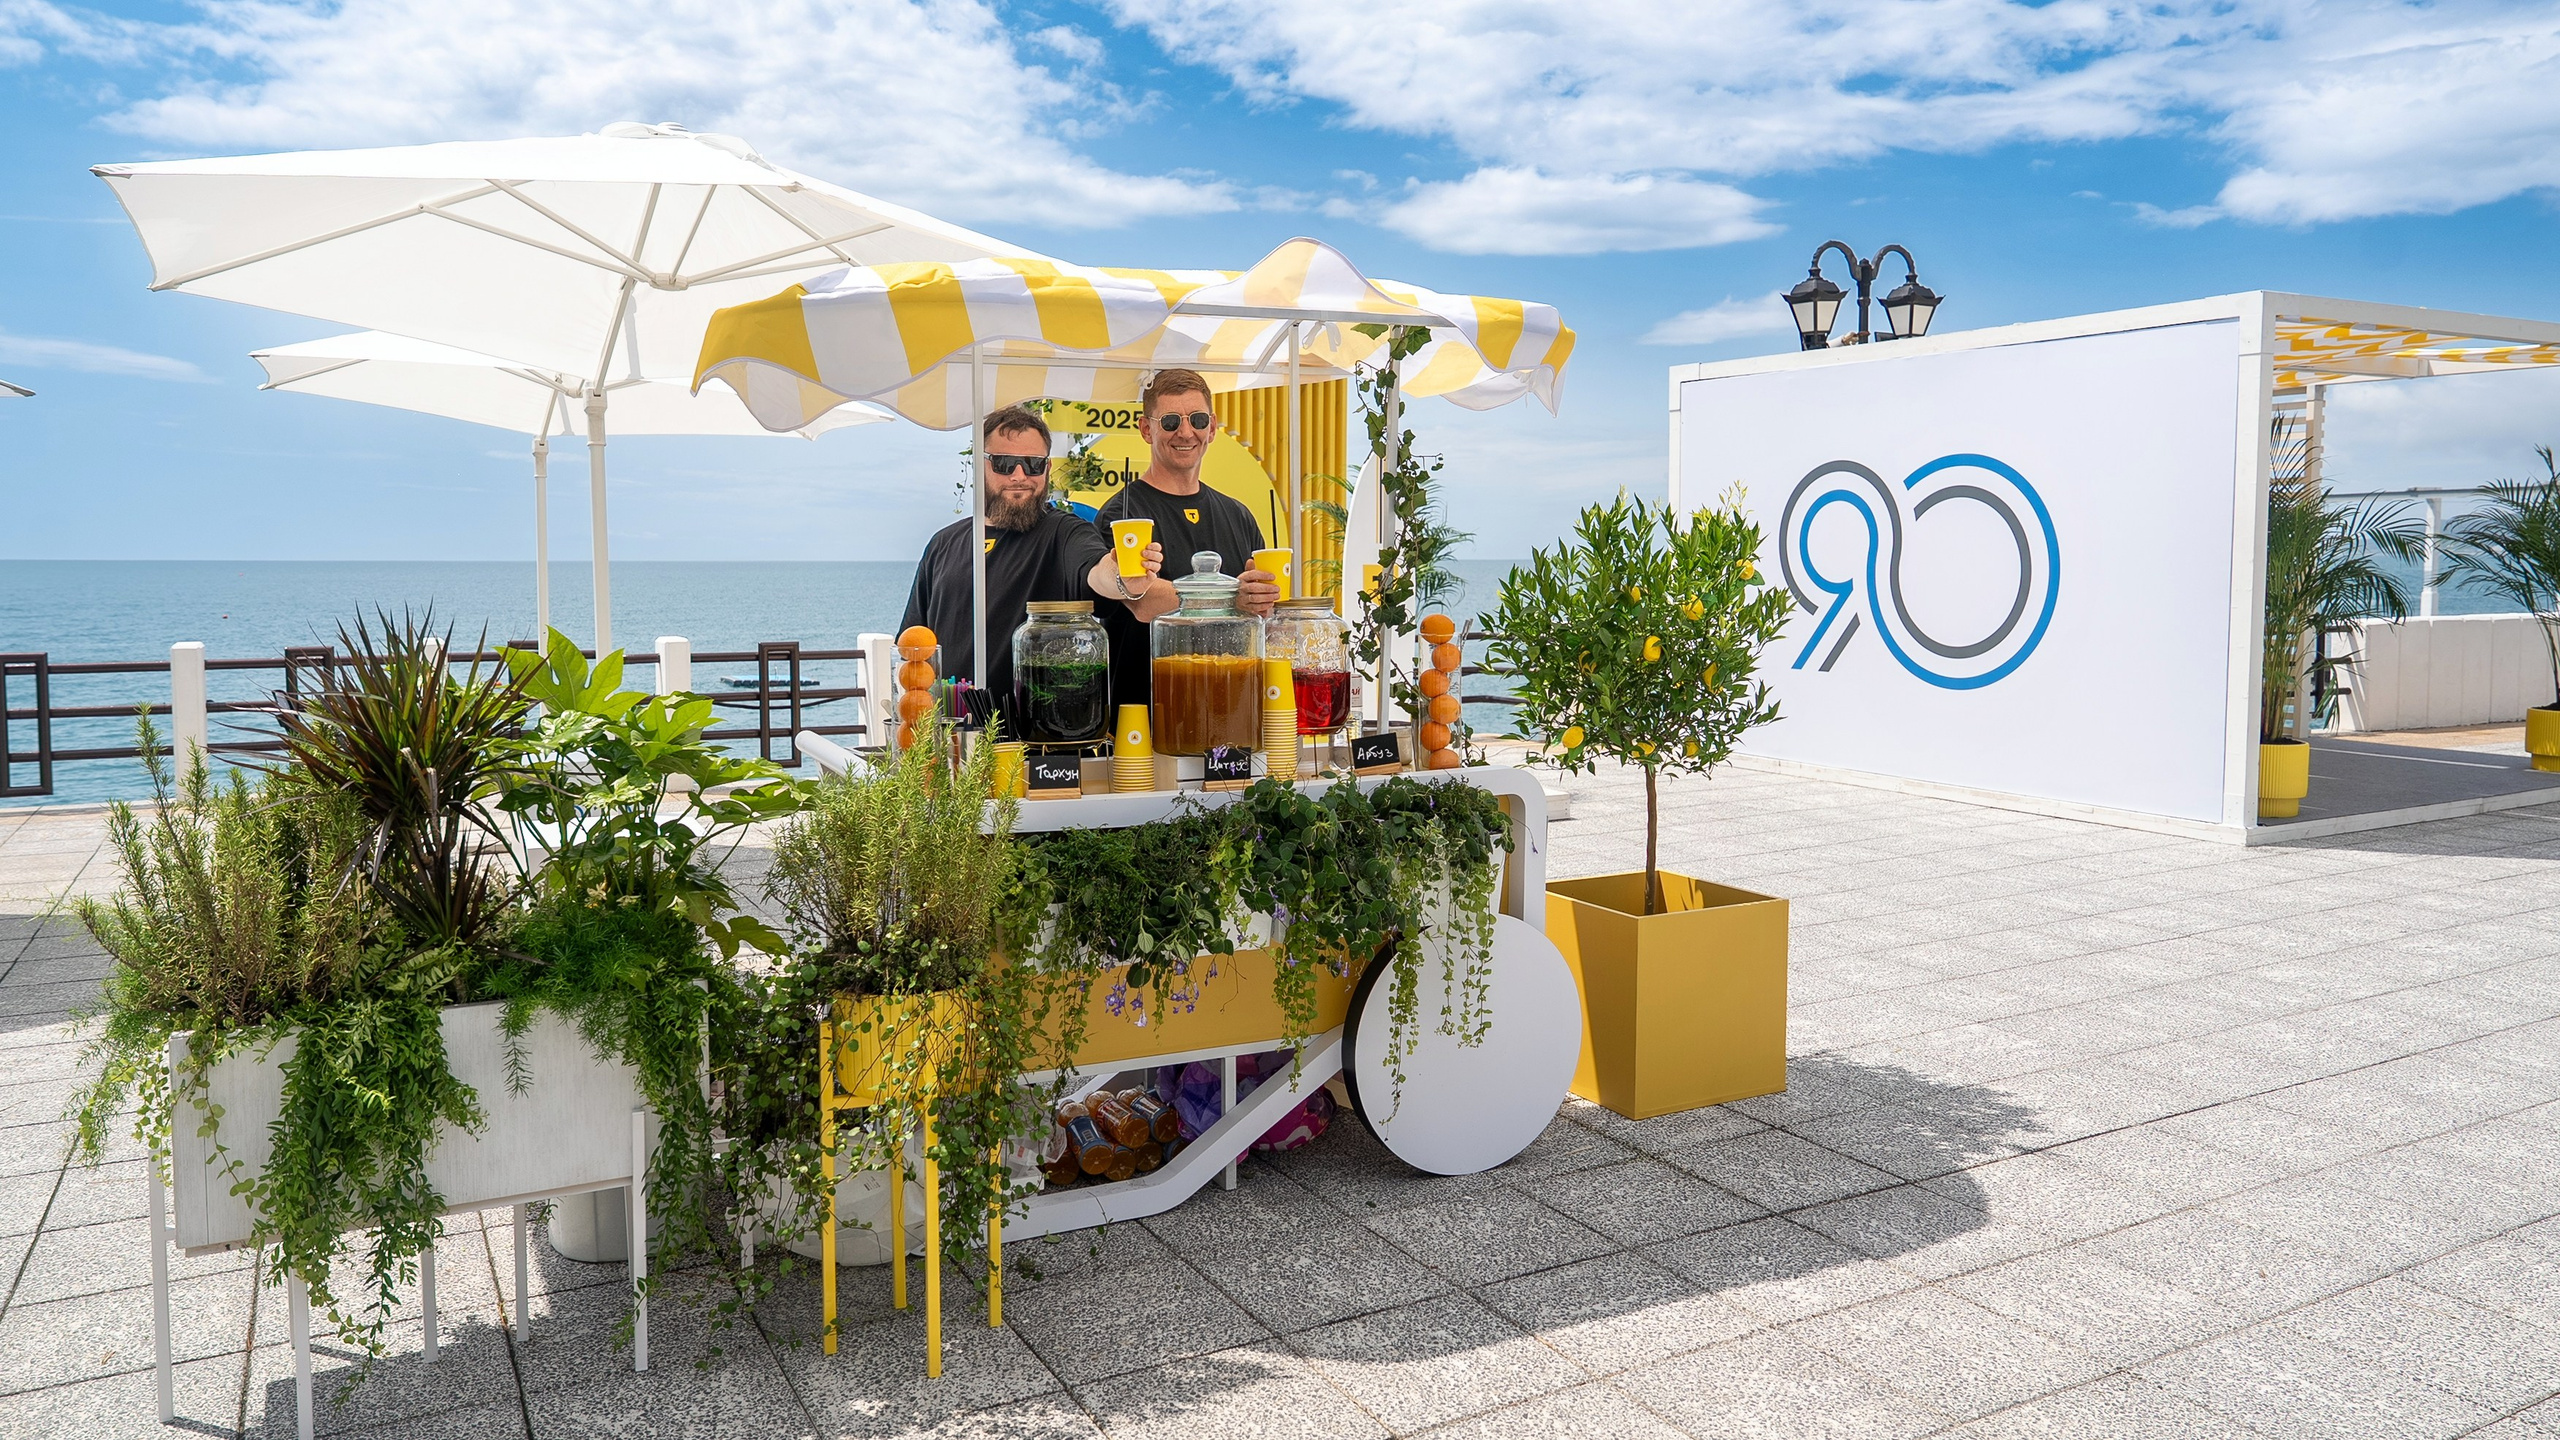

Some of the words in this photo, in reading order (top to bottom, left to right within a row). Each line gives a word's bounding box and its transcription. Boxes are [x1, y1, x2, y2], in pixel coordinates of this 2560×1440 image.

[1086, 408, 1143, 429] 2025
[1357, 745, 1394, 760] Арбуз
[1035, 763, 1079, 781] Тархун
[1208, 757, 1249, 772] Цитус
